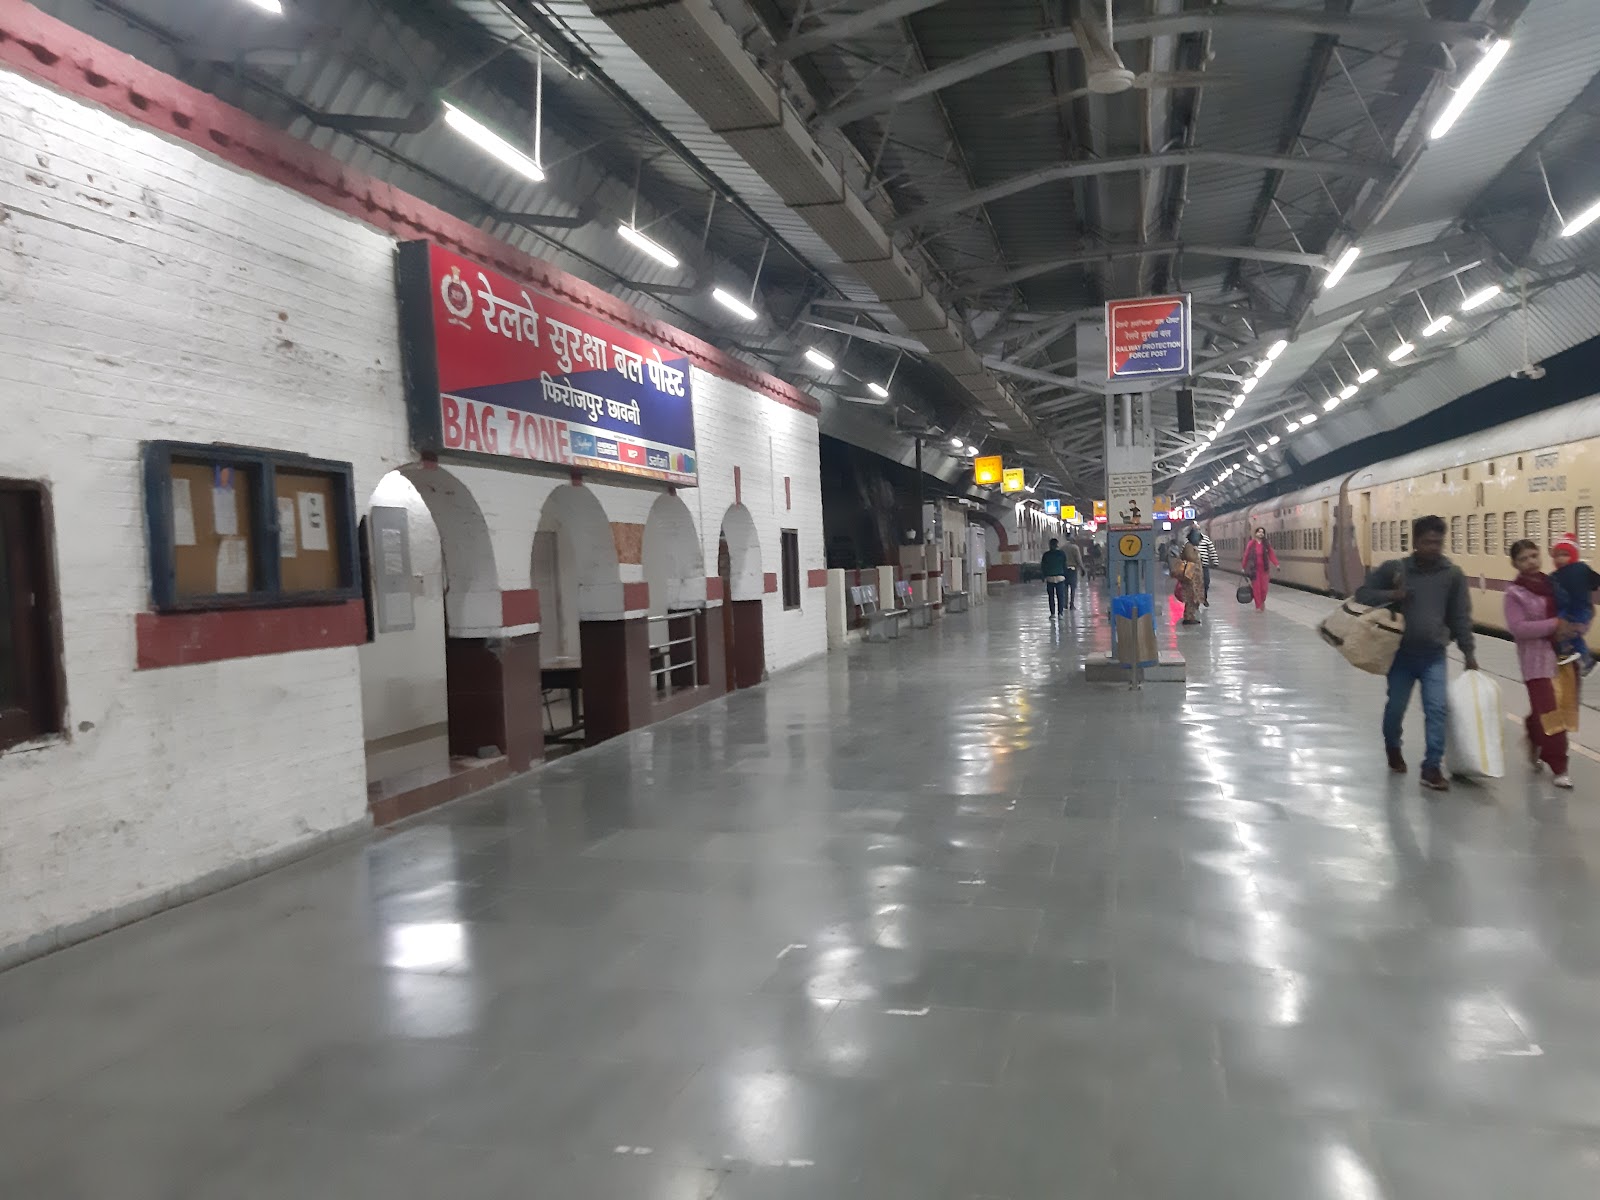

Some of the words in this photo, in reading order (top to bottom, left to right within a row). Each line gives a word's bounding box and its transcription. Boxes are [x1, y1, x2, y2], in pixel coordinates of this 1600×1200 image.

[478, 272, 539, 347] रेलवे
[546, 317, 607, 373] सुरक्षा
[612, 343, 643, 384] बल
[646, 348, 685, 397] पोस्ट
[1142, 342, 1181, 350] PROTECTION
[1150, 350, 1167, 358] POST
[540, 371, 604, 422] फिरोजपुर
[606, 398, 641, 426] छावनी
[442, 397, 499, 454] BAG
[507, 410, 569, 465] ZONE
[1126, 540, 1134, 551] 7
